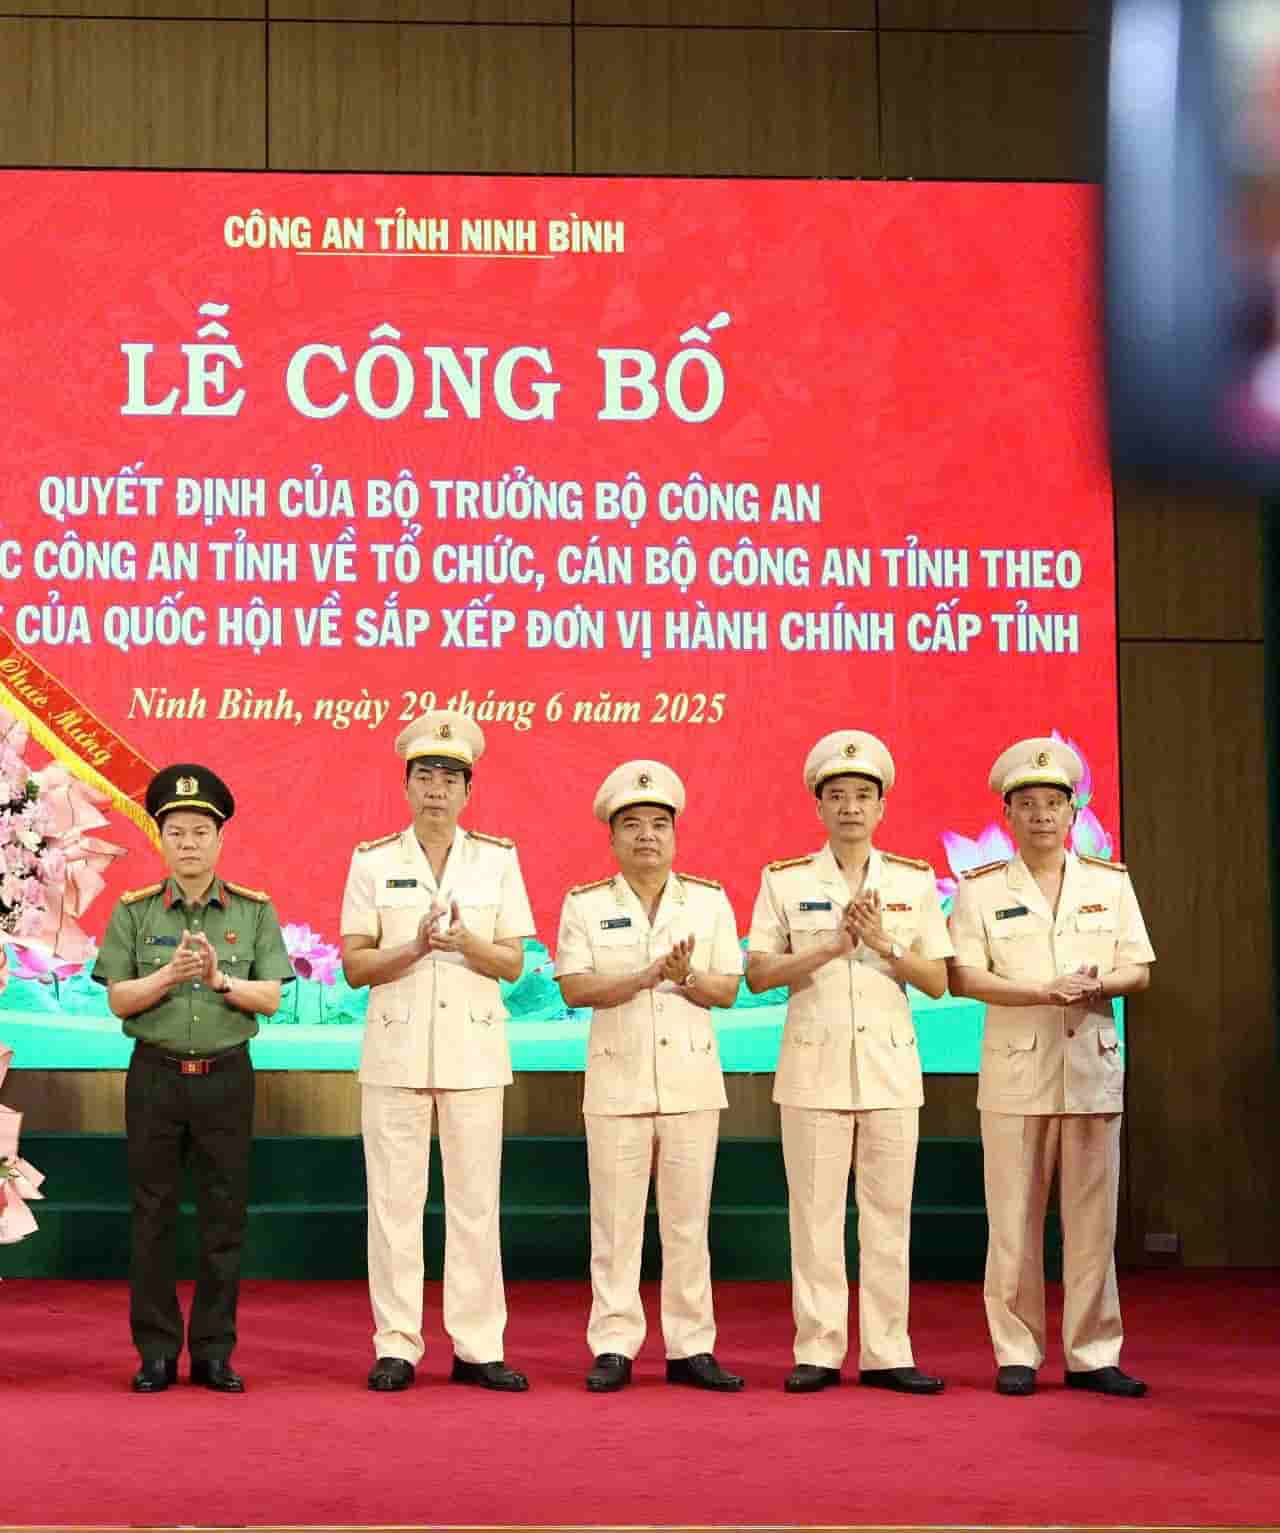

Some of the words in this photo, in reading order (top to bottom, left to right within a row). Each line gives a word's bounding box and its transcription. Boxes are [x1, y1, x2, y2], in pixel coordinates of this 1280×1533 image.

[224, 208, 312, 250] CÔNG
[321, 217, 365, 251] AN
[375, 207, 449, 252] TỈNH
[461, 218, 537, 252] NINH
[548, 212, 625, 254] BÌNH
[120, 302, 246, 417] LỄ
[285, 322, 561, 421] CÔNG
[596, 311, 731, 424] BỐ
[39, 461, 164, 523] QUYẾT
[175, 477, 266, 526] ĐỊNH
[278, 463, 355, 519] CỦA
[367, 470, 419, 527] BỘ
[429, 465, 584, 521] TRƯỞNG
[595, 471, 648, 528] BỘ
[658, 471, 760, 523] CÔNG
[770, 483, 821, 522] AN
[33, 529, 137, 581] CÔNG
[146, 541, 198, 582] AN
[208, 527, 297, 582] TỈNH
[309, 526, 358, 583] VỀ
[370, 522, 423, 584] TỔ
[432, 534, 545, 592] CHỨC,
[557, 536, 632, 586] CÁN
[645, 535, 697, 594] BỘ
[708, 536, 810, 587] CÔNG
[820, 547, 871, 587] AN
[880, 534, 969, 588] TỈNH
[979, 549, 1082, 589] THEO
[15, 590, 92, 646] CỦA
[103, 590, 207, 653] QUỐC
[218, 596, 283, 655] HỘI
[294, 589, 343, 647] VỀ
[354, 591, 431, 648] SẮP
[440, 593, 516, 649] XẾP
[525, 603, 605, 650] ĐƠN
[615, 610, 652, 659] VỊ
[665, 600, 768, 651] HÀNH
[779, 601, 895, 652] CHÍNH
[907, 597, 982, 652] CẤP
[991, 599, 1079, 653] TỈNH
[127, 687, 207, 721] Ninh
[216, 687, 303, 727] Bình,
[313, 687, 390, 731] ngày
[398, 689, 437, 722] 29
[447, 688, 537, 732] tháng
[545, 690, 566, 723] 6
[572, 691, 641, 724] năm
[650, 692, 727, 725] 2025
